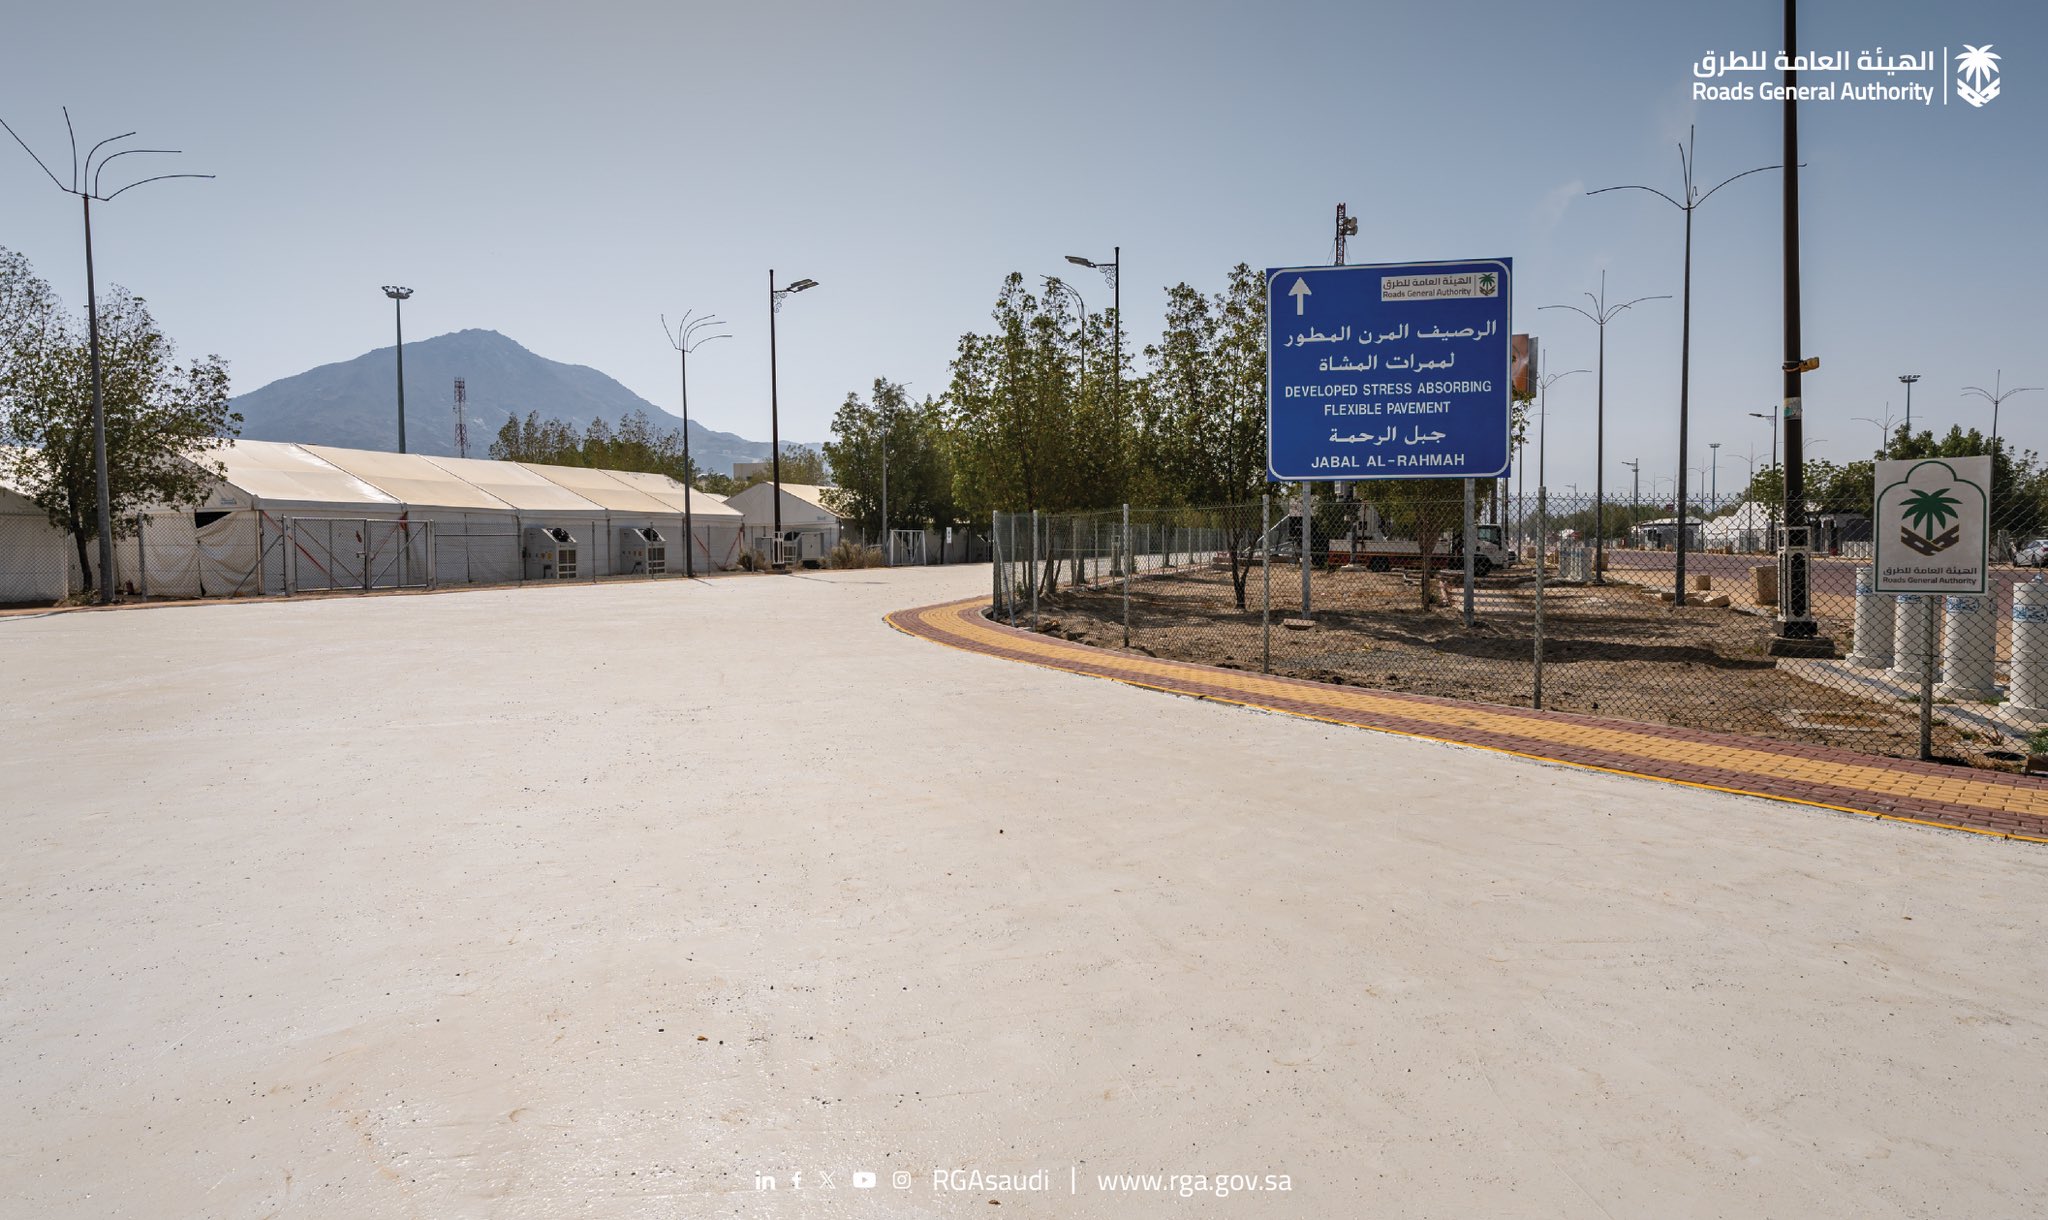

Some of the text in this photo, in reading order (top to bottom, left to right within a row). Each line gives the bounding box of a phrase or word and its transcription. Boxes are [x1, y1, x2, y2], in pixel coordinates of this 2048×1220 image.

[1383, 275, 1471, 290] الهيئة العامة للطرق
[1407, 289, 1435, 297] General
[1436, 288, 1471, 297] Authority
[1284, 319, 1497, 347] الرصيف المرن المطور
[1319, 352, 1455, 373] لممرات المشاة
[1285, 380, 1492, 398] DEVELOPED STRESS ABSORBING
[1324, 401, 1451, 416] FLEXIBLE PAVEMENT
[1329, 425, 1446, 446] جبل الرحمة
[1311, 453, 1465, 468] JABAL AL-RAHMAH
[1939, 577, 1977, 585] Authority
